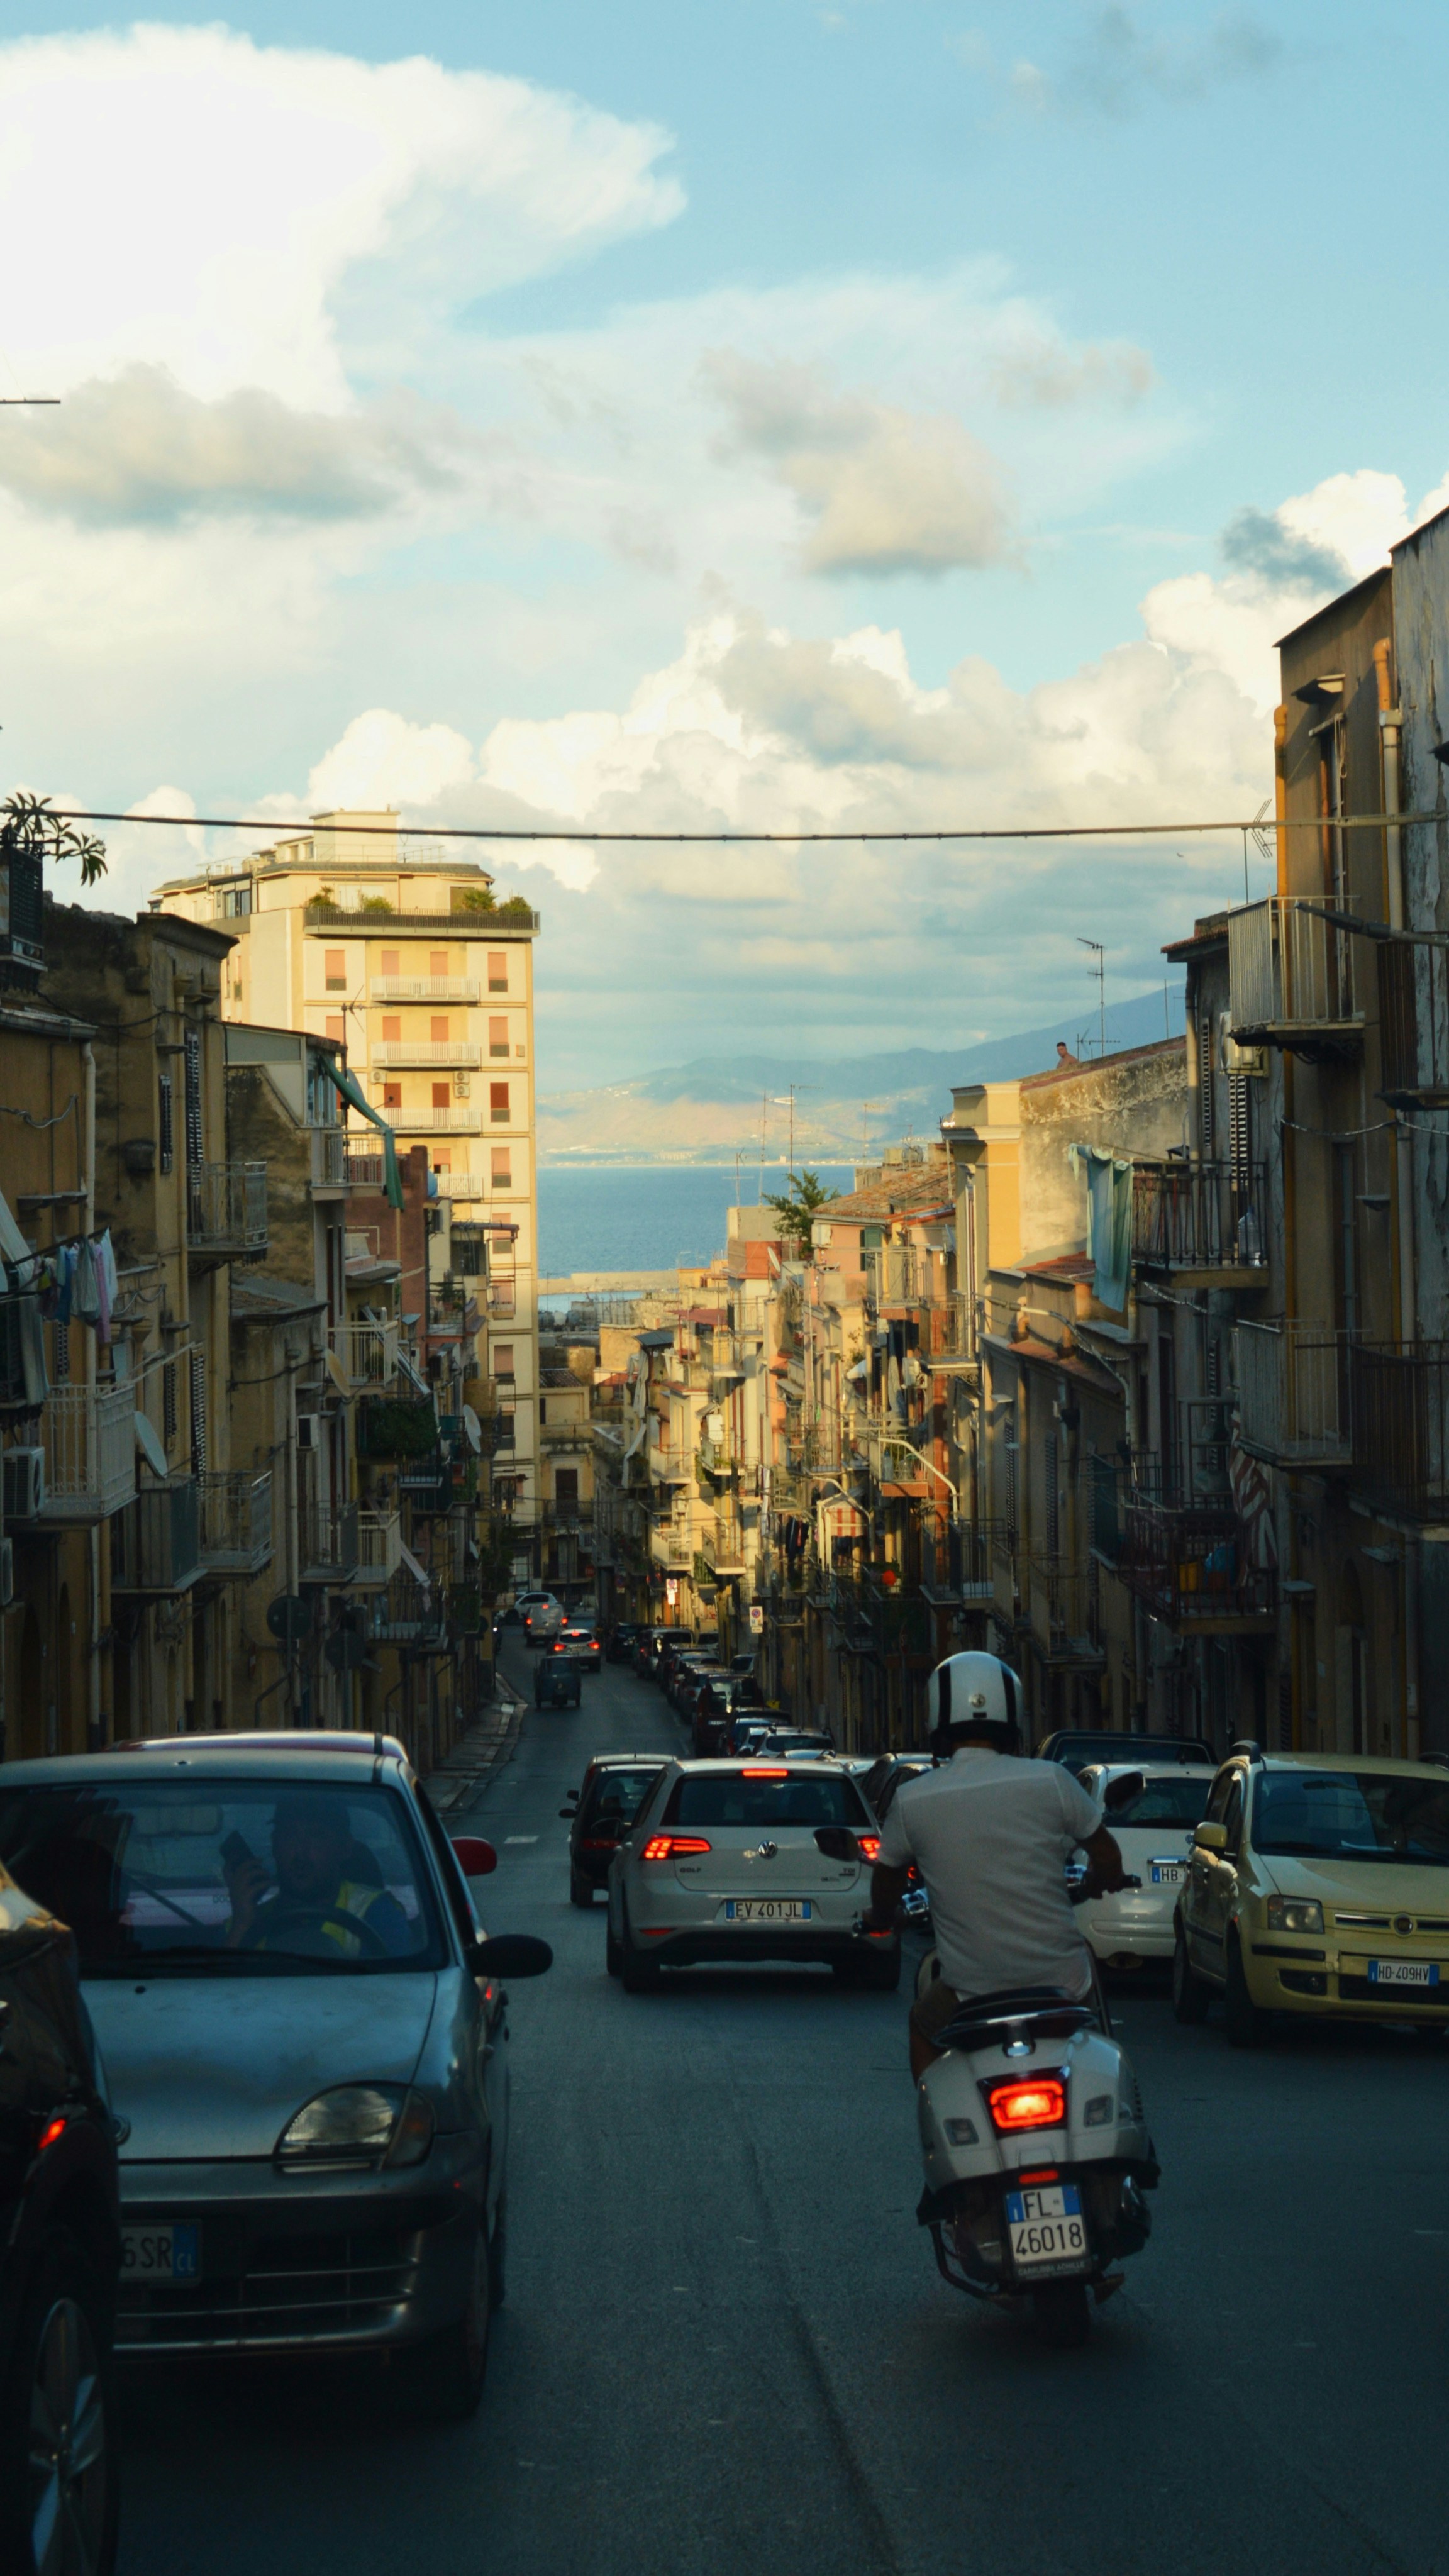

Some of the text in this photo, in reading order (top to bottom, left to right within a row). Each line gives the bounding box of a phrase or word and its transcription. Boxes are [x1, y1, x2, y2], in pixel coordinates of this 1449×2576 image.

[1162, 1868, 1178, 1881] HB
[1016, 2222, 1082, 2255] 46018
[176, 2252, 195, 2272] CL
